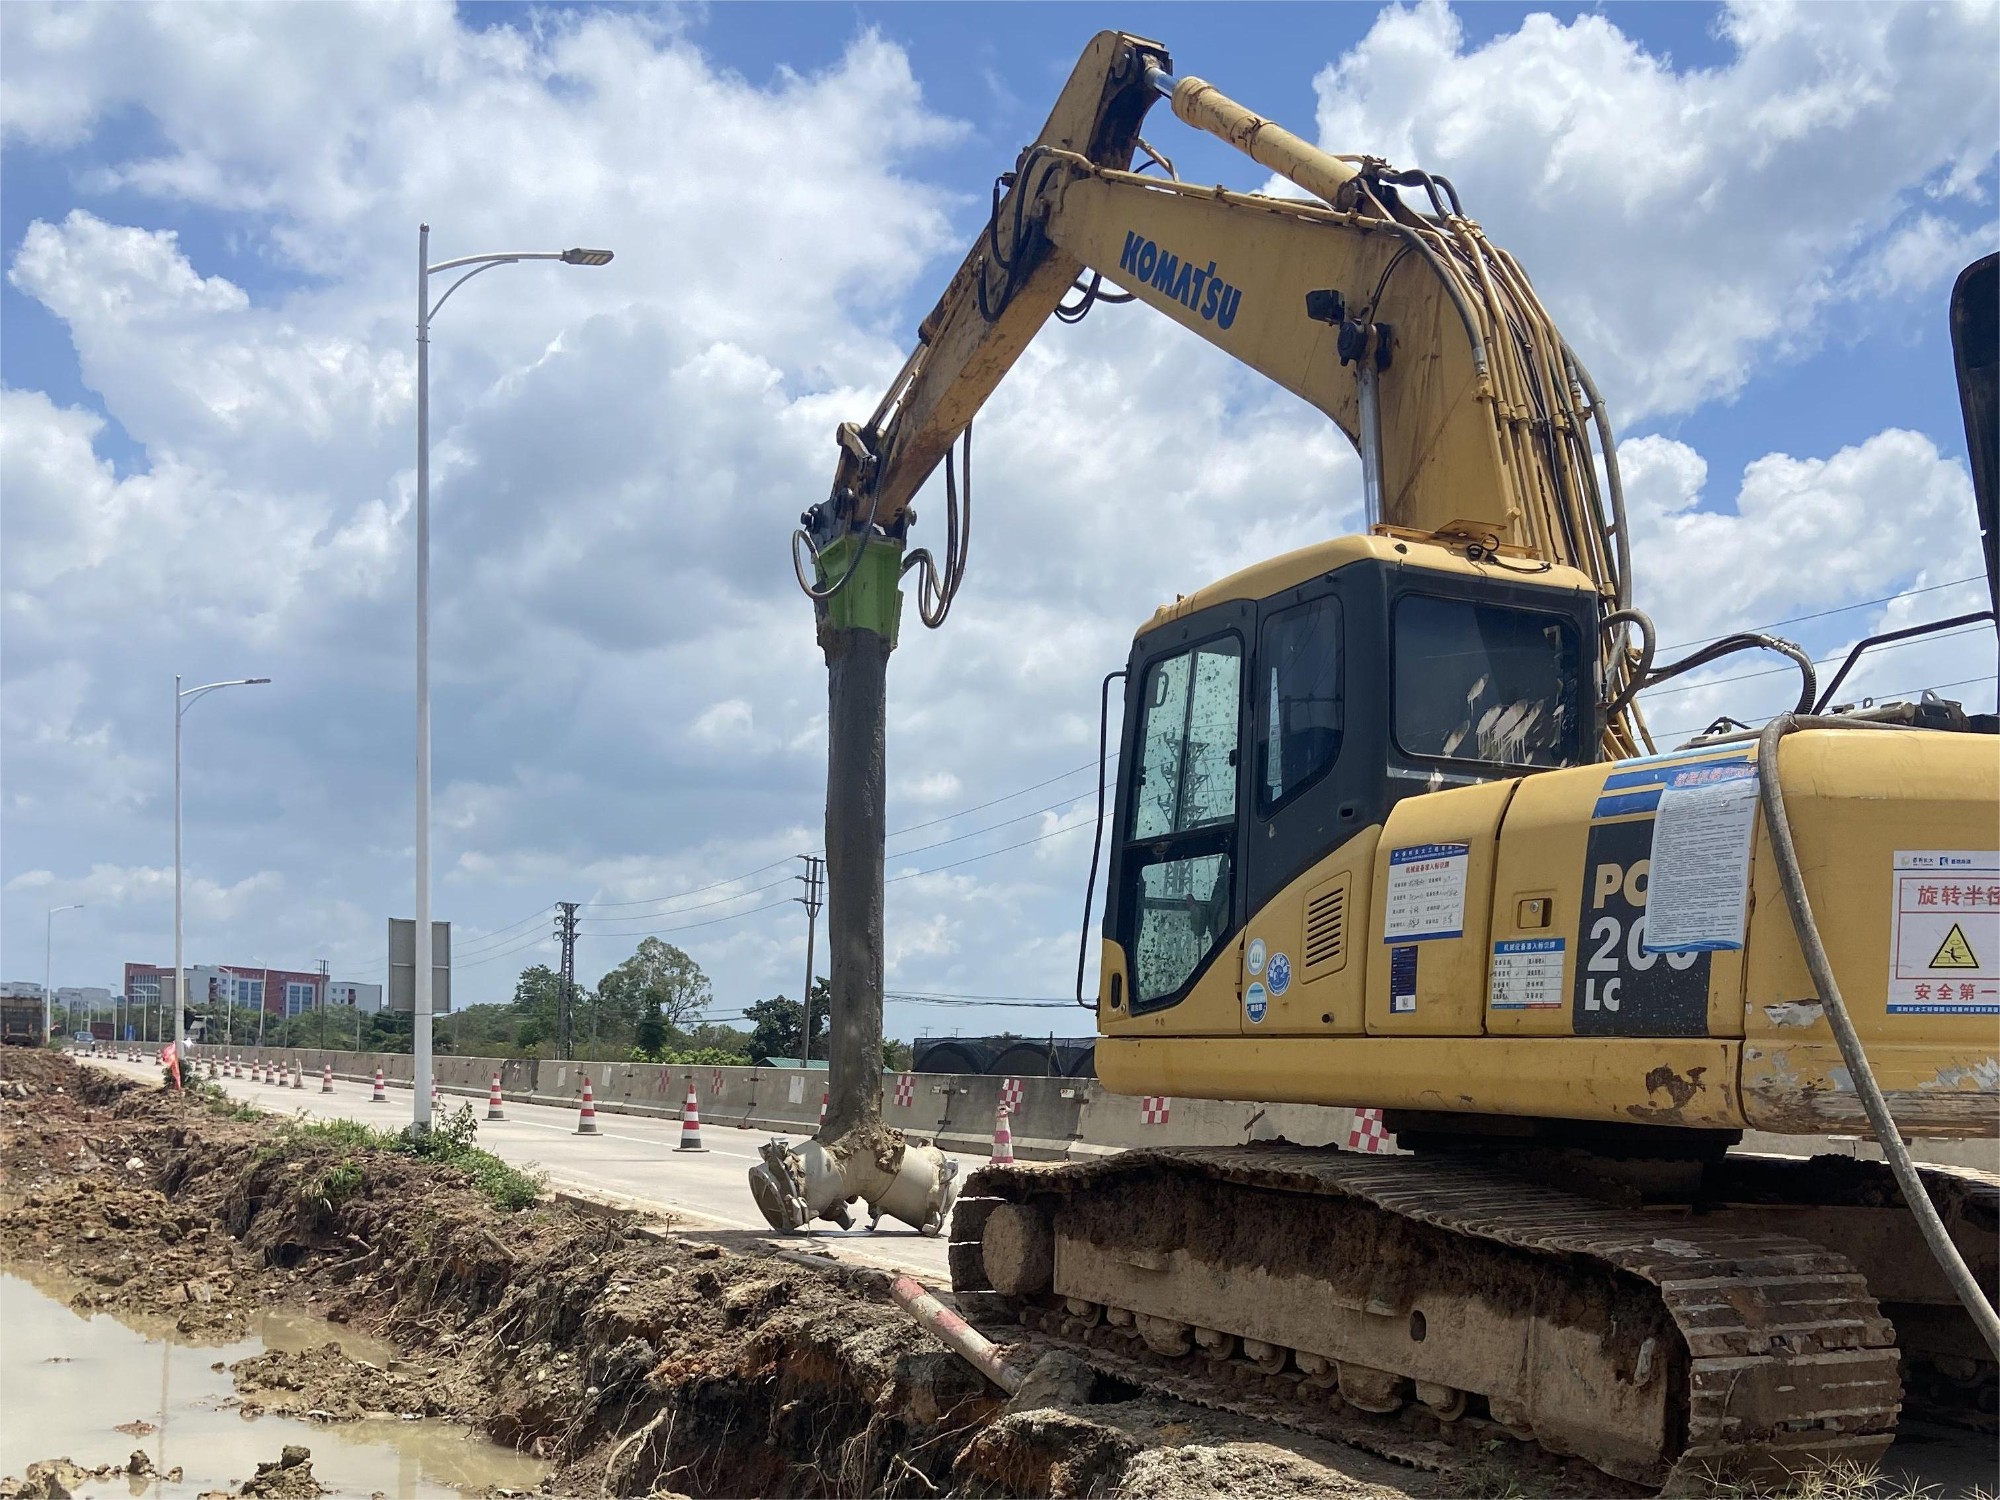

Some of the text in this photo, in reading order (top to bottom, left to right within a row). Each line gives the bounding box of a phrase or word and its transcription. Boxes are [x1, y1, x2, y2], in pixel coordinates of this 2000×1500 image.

[1119, 230, 1242, 330] KOMATSU
[1584, 977, 1621, 1012] LC
[1914, 983, 1997, 1001] 安全第一
